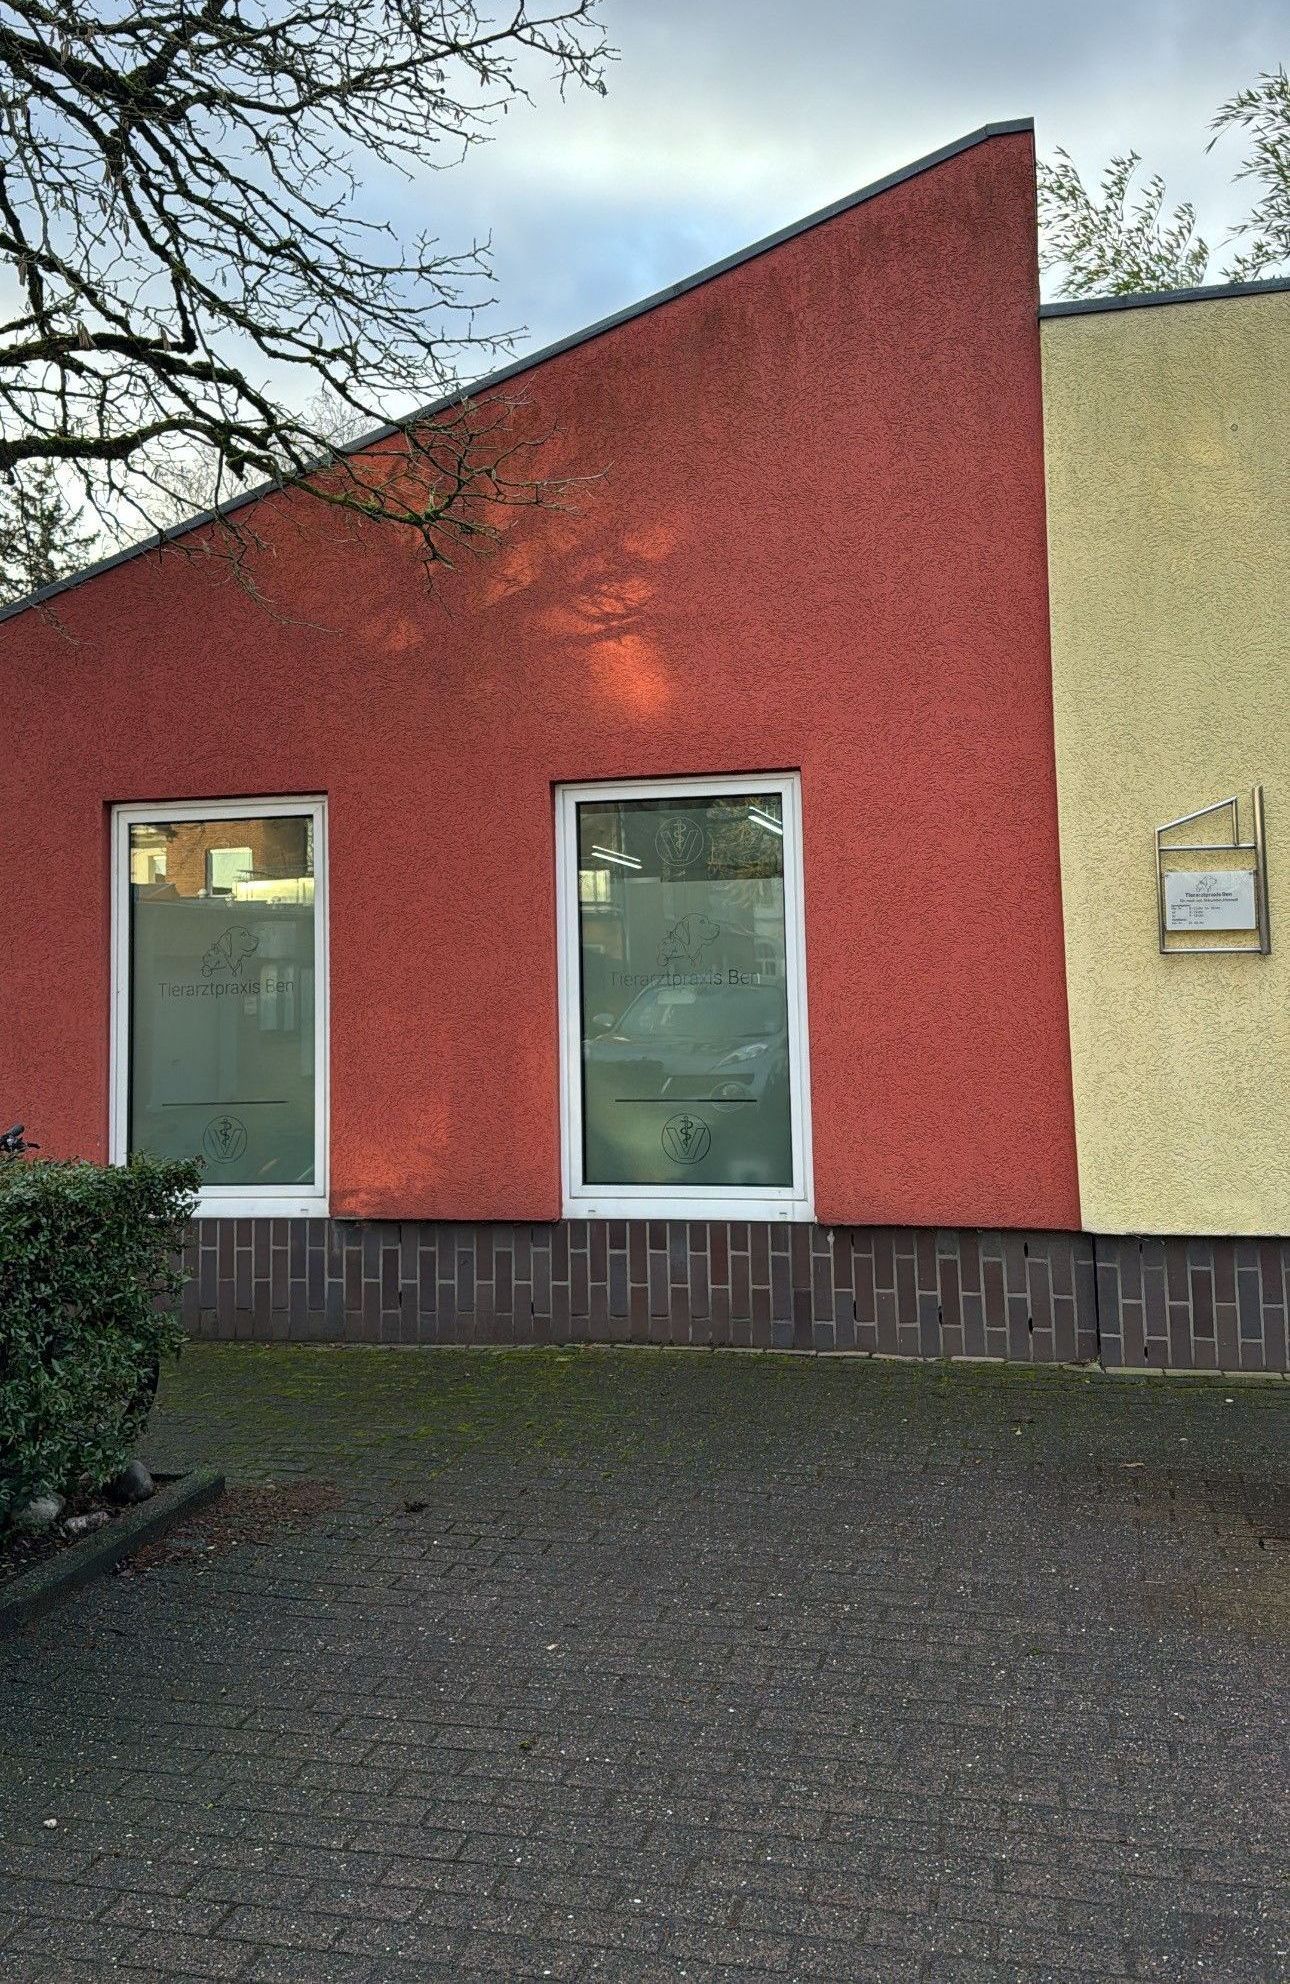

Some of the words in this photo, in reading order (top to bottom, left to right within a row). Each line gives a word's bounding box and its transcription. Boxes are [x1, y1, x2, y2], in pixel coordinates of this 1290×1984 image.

[611, 969, 722, 988] Tierarztpraxis
[728, 969, 761, 986] Ben
[158, 980, 261, 998] Tierarztpraxis
[266, 979, 295, 994] Ben
